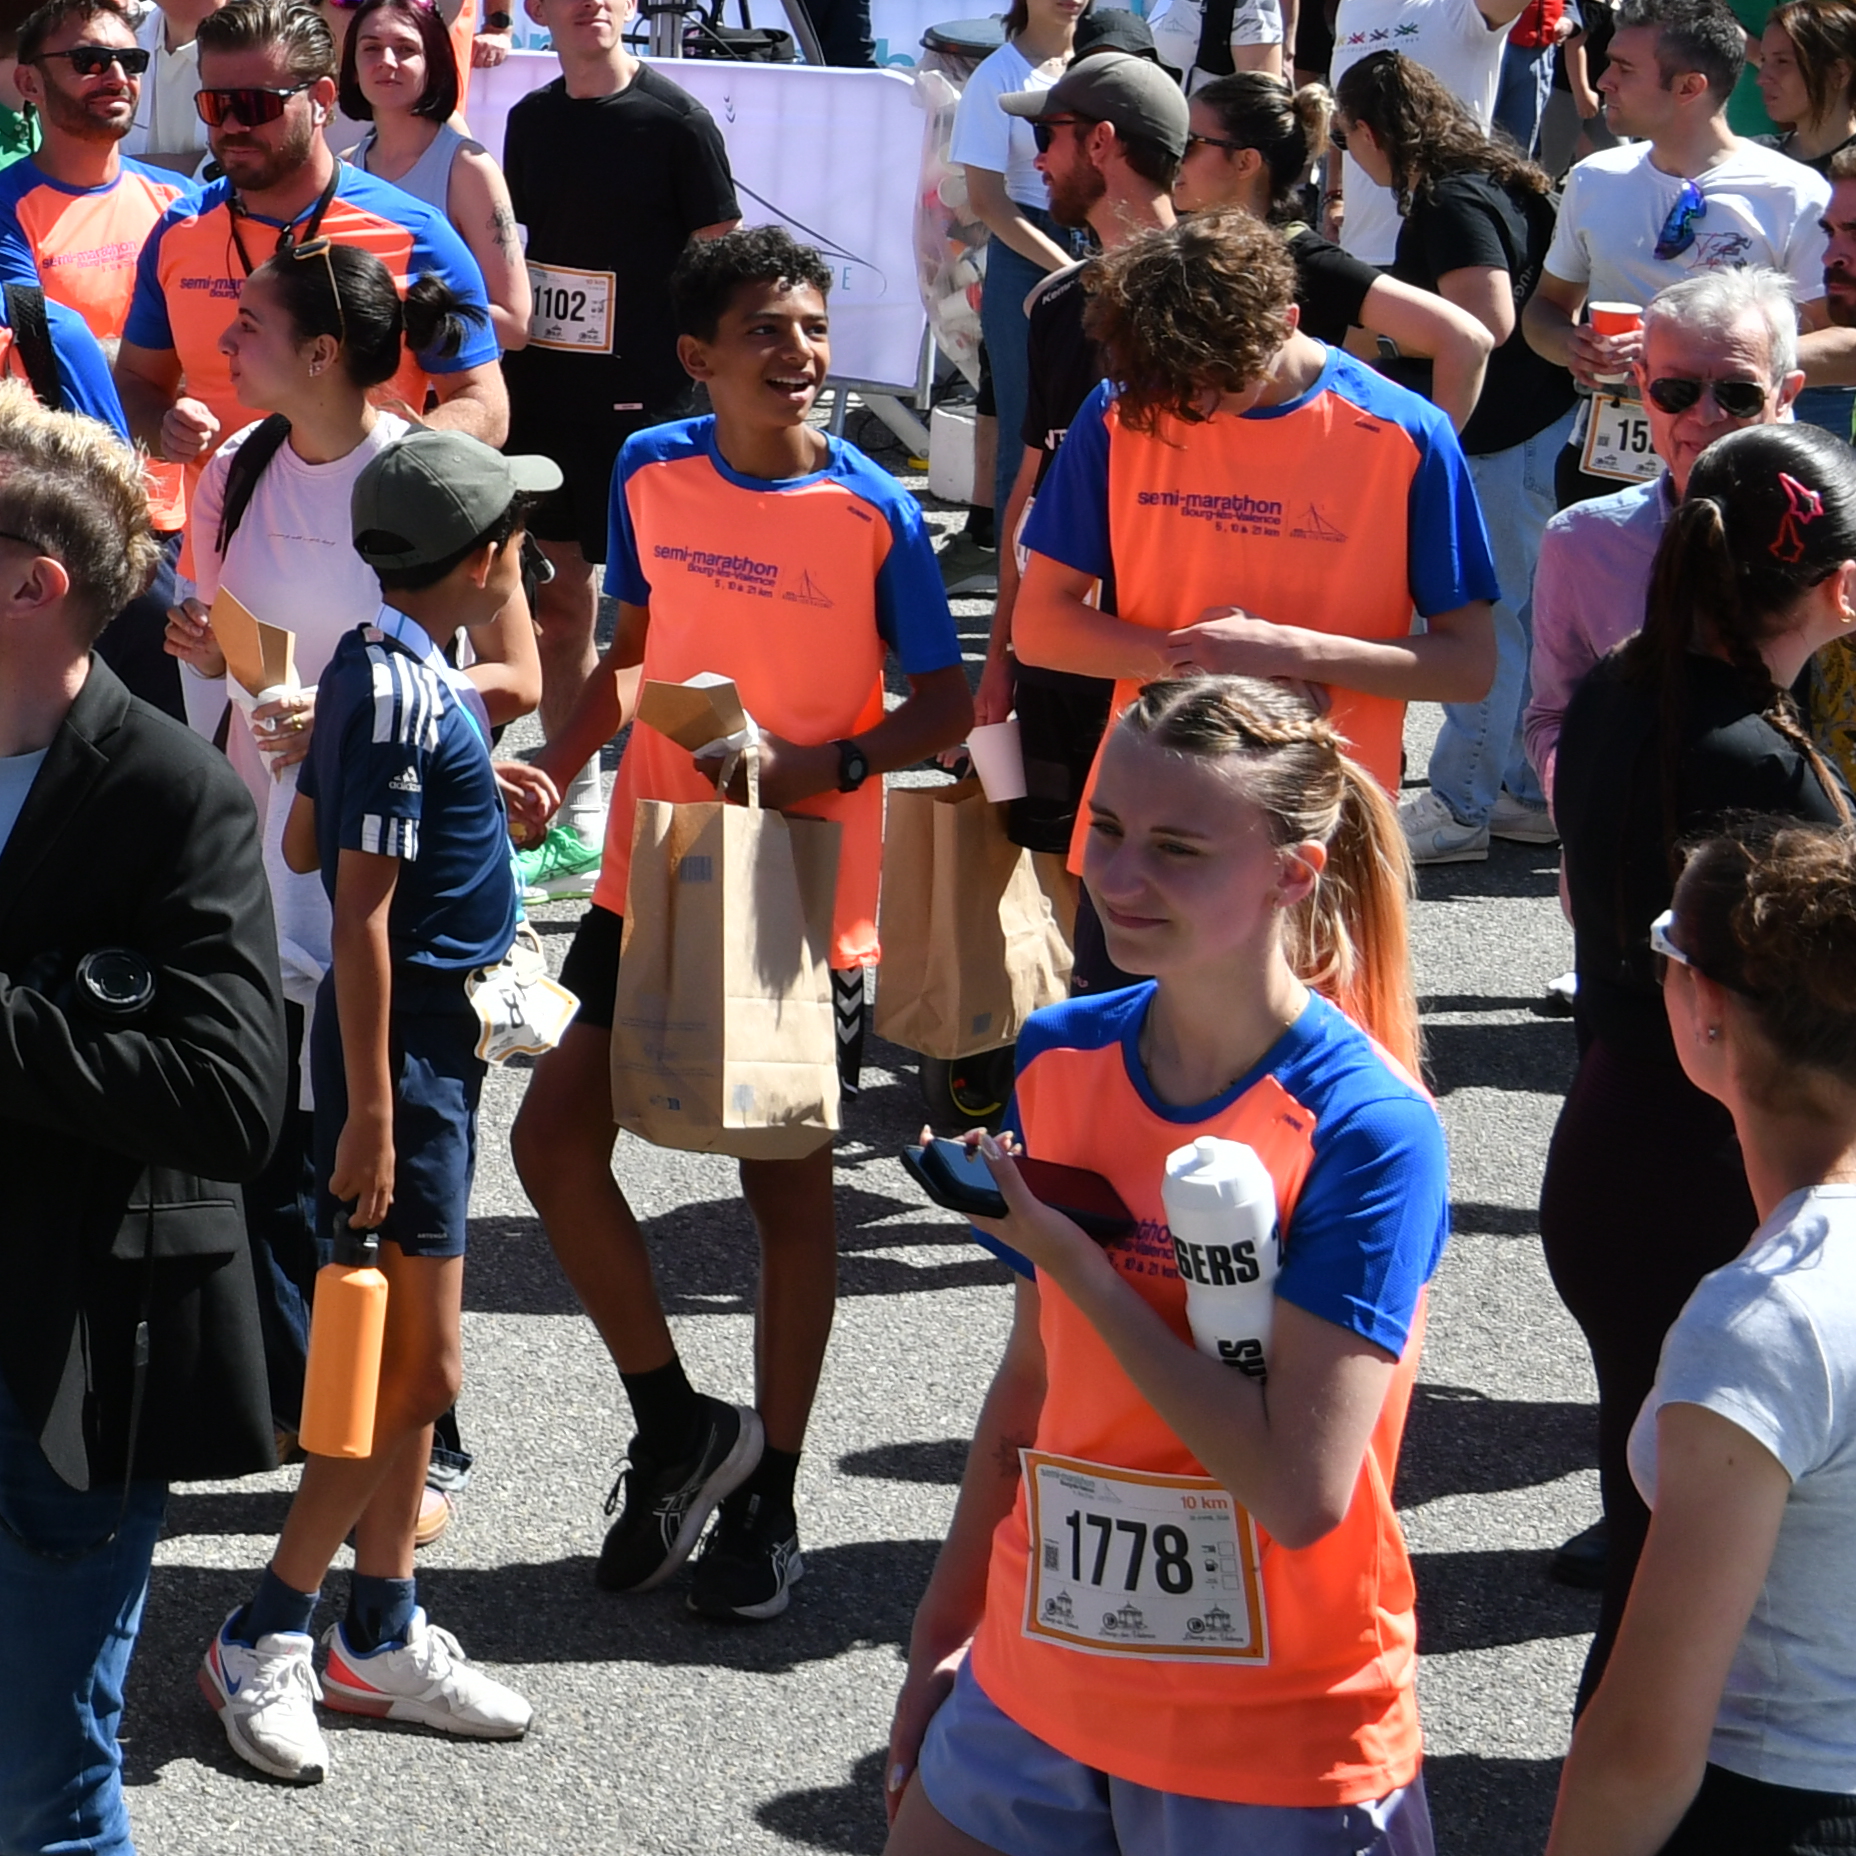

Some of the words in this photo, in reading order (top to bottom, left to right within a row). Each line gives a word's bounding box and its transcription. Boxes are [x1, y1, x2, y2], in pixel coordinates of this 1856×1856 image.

[534, 284, 587, 322] 1102
[1617, 417, 1658, 455] 15
[1137, 489, 1282, 515] semi-marathon
[654, 544, 779, 578] semi-marathon
[1181, 1495, 1197, 1510] 10
[1201, 1495, 1228, 1510] km
[1064, 1508, 1194, 1596] 1778
